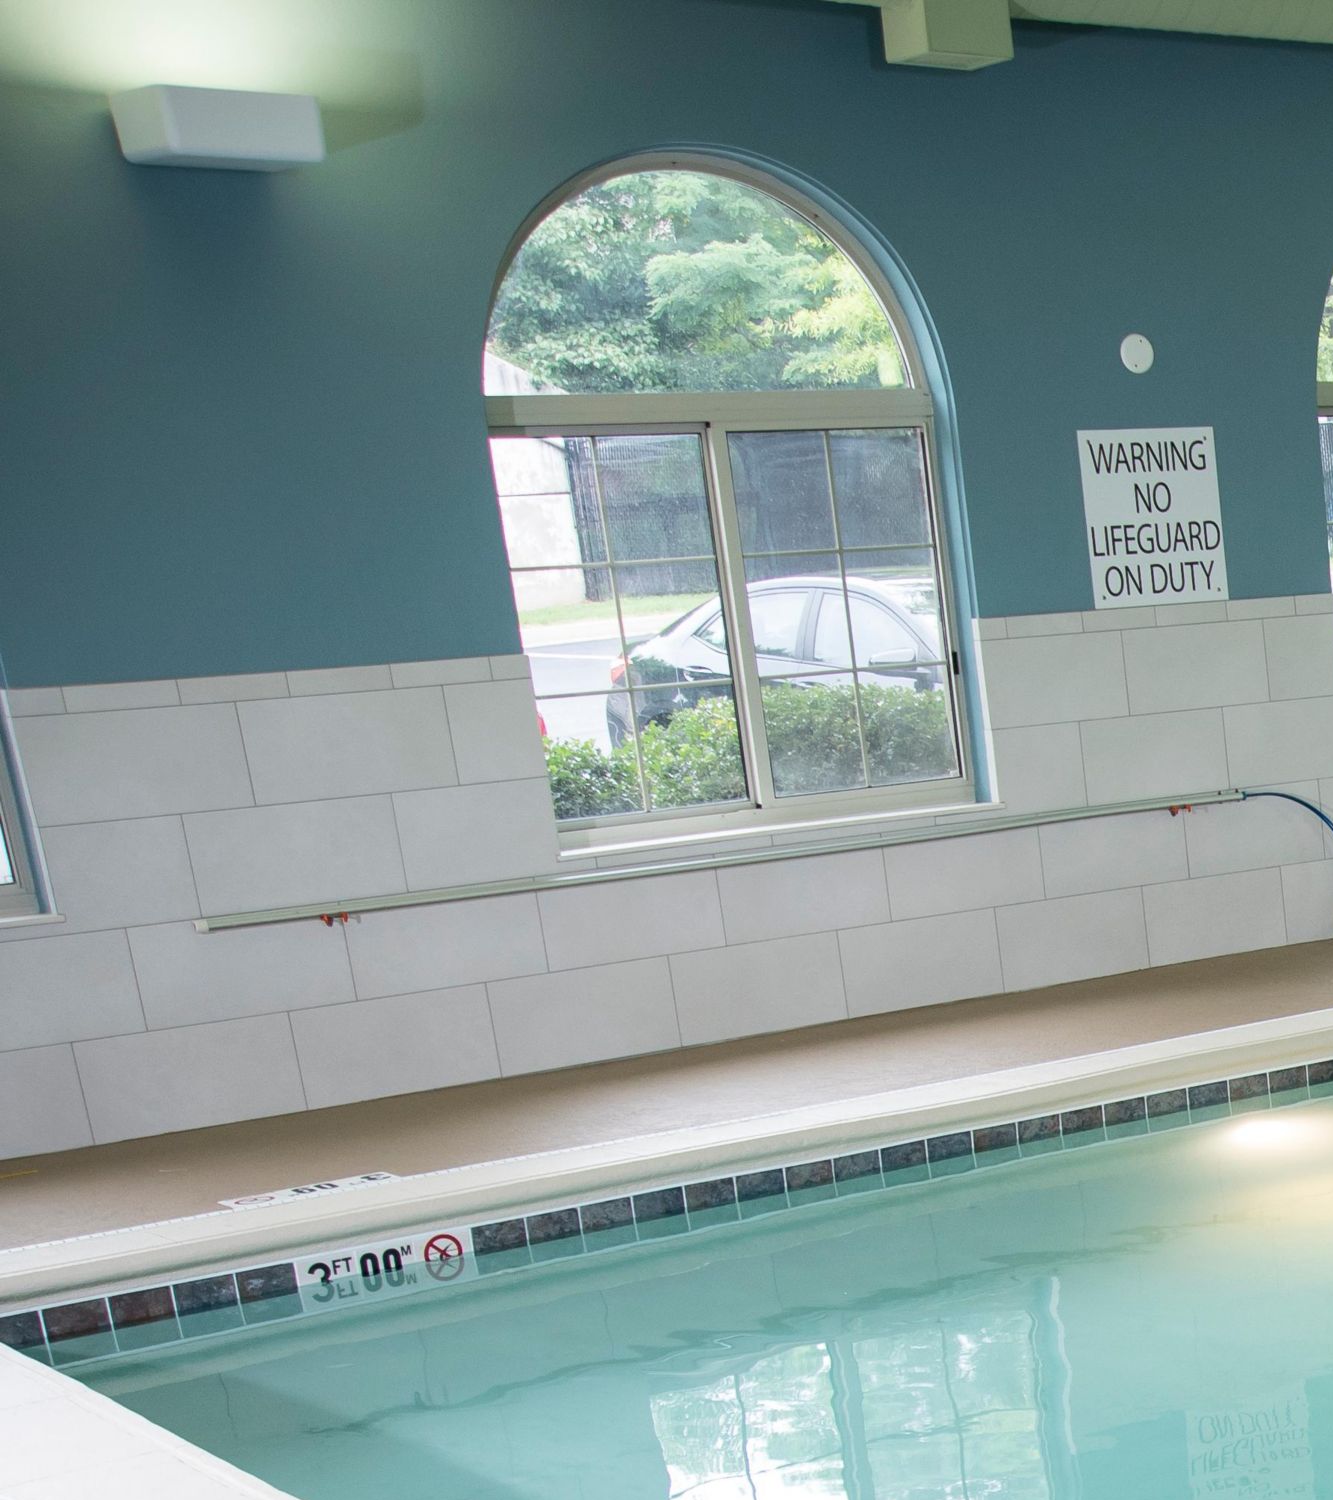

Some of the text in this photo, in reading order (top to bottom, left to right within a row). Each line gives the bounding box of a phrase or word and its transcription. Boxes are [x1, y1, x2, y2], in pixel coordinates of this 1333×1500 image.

[1086, 440, 1207, 475] WARNING
[1134, 482, 1172, 514] NO
[1091, 520, 1221, 557] LIFEGUARD
[1105, 560, 1215, 598] ON DUTY
